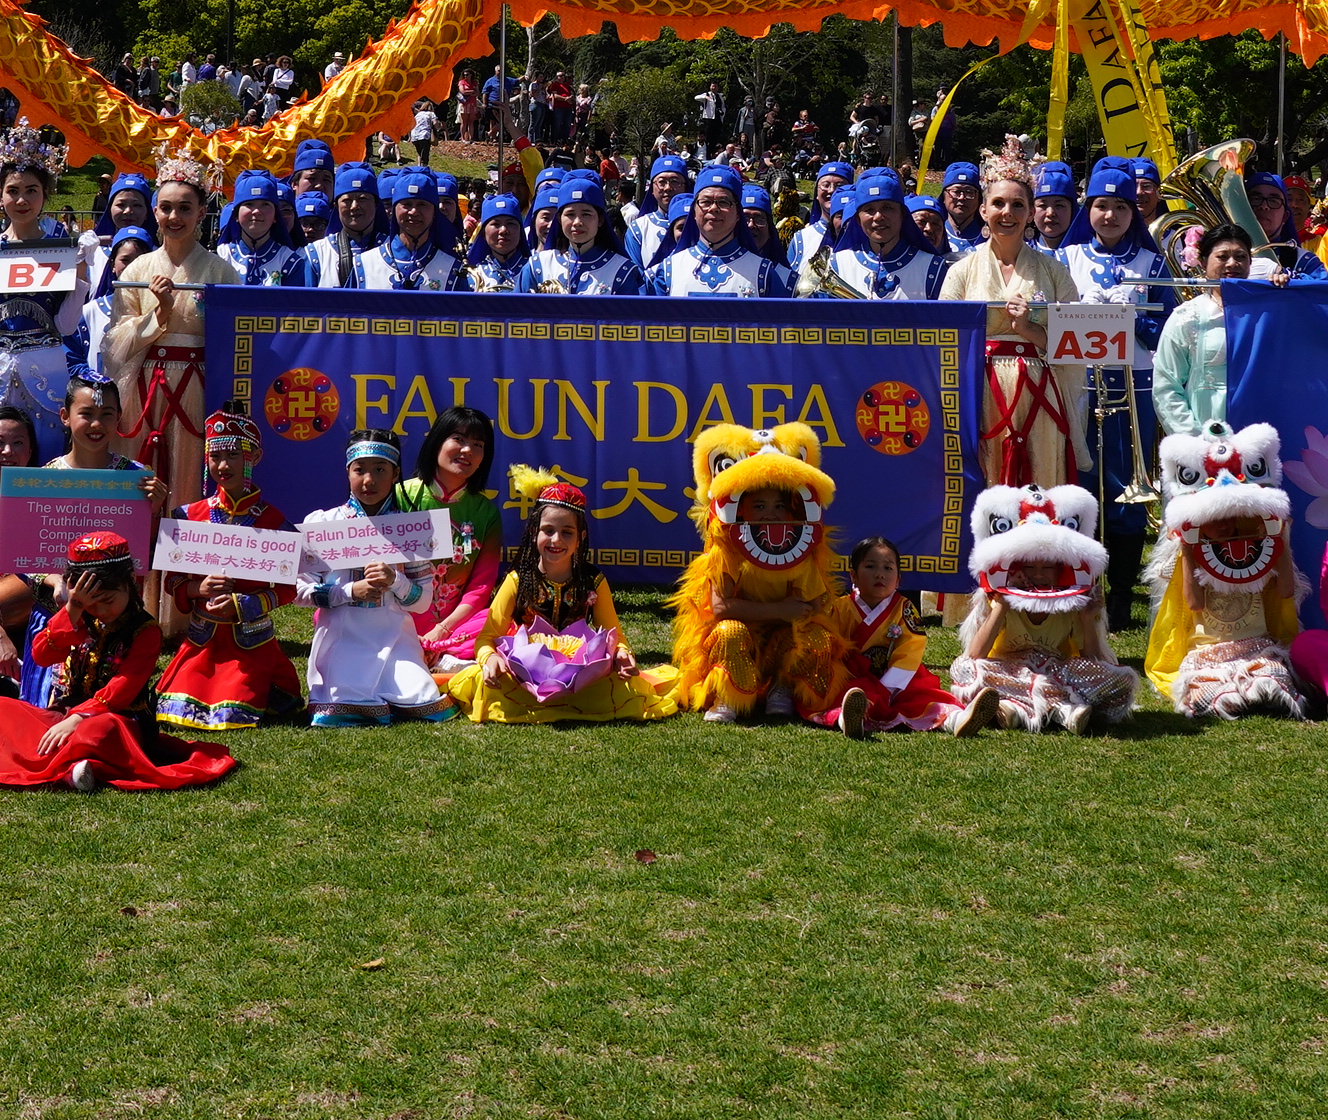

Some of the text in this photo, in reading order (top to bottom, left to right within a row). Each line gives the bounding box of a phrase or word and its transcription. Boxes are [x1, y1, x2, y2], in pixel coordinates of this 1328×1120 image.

[7, 262, 61, 288] B7
[1053, 330, 1127, 360] A31
[632, 381, 846, 447] DAFA
[26, 501, 133, 515] The world needs
[41, 515, 114, 528] Truthfulness
[306, 519, 431, 543] Falun Dafa is good
[172, 528, 296, 553] Falun Dafa is good
[321, 540, 422, 561] 法輪大法好
[185, 551, 277, 572] 法輪大法好
[1203, 611, 1250, 633] TOGETHE
